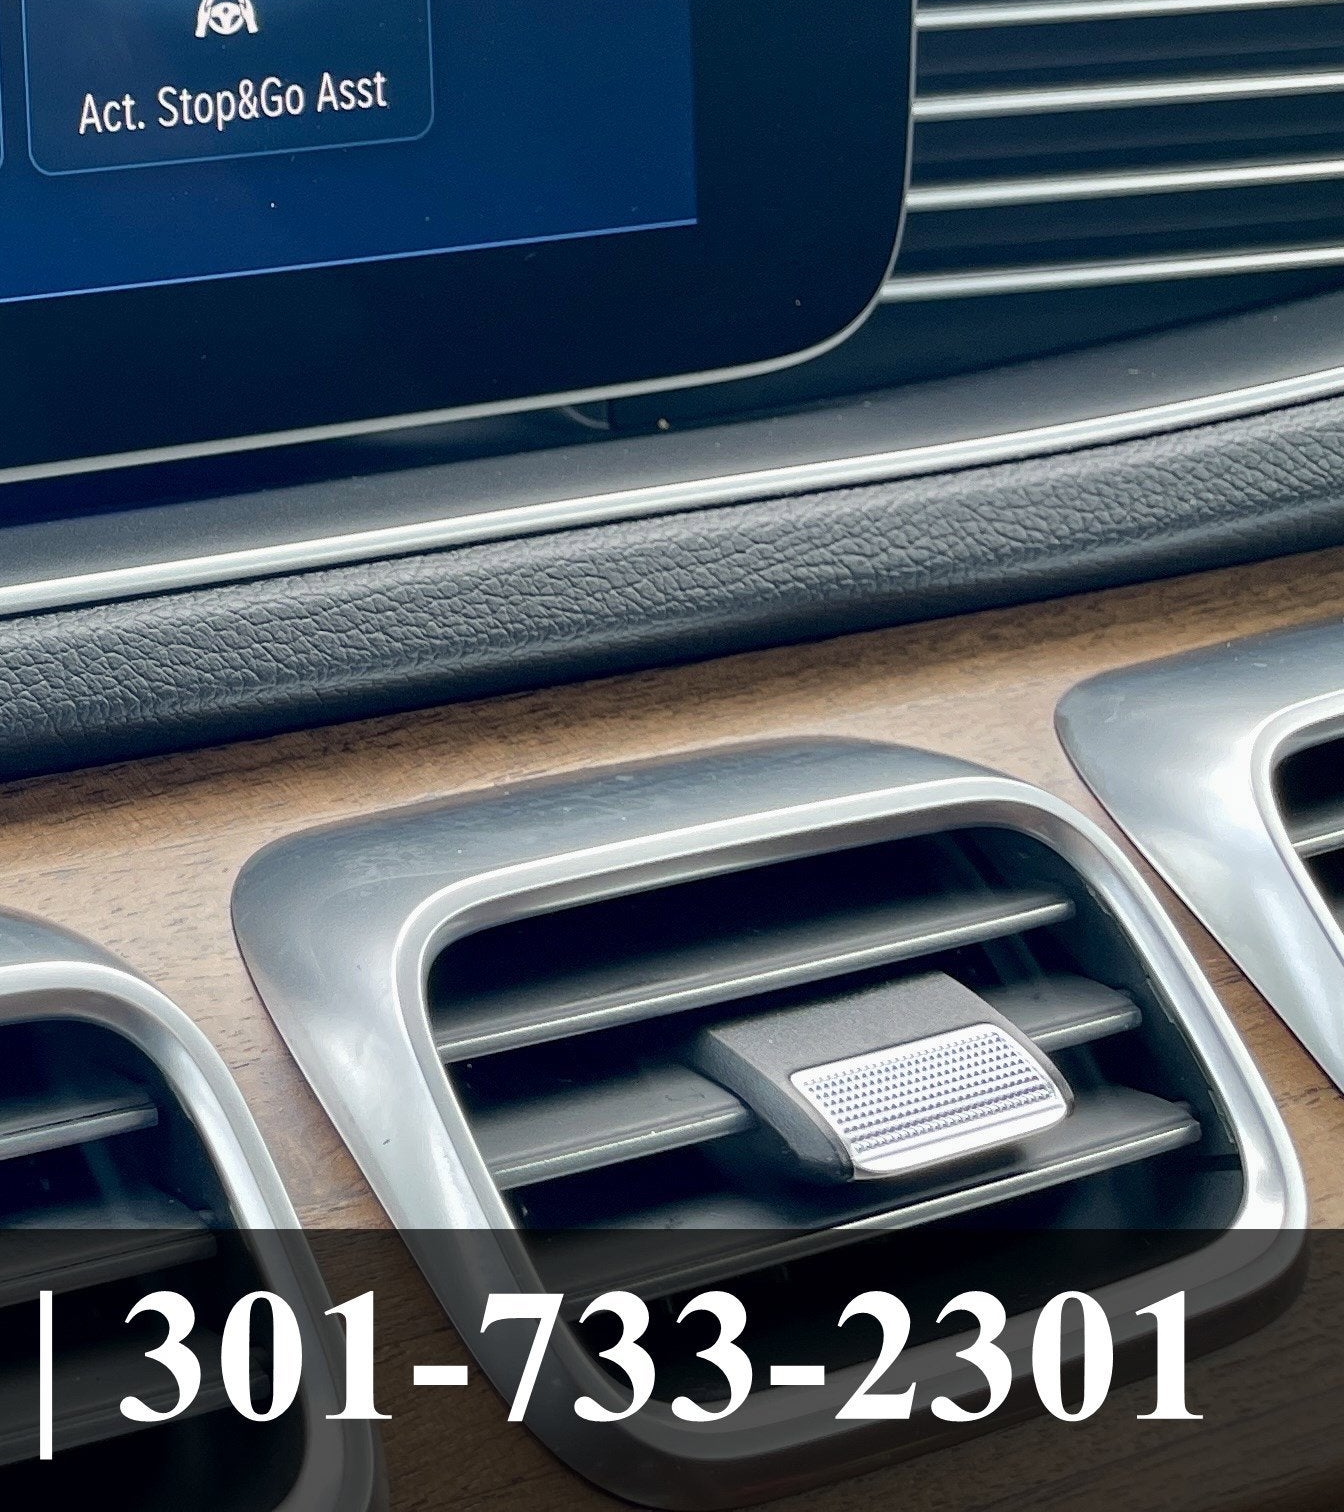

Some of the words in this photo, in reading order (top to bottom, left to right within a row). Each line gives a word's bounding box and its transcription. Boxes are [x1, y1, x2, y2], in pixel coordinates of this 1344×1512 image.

[78, 92, 146, 135] Act.
[157, 76, 305, 132] Stop&Go
[316, 71, 388, 113] Asst
